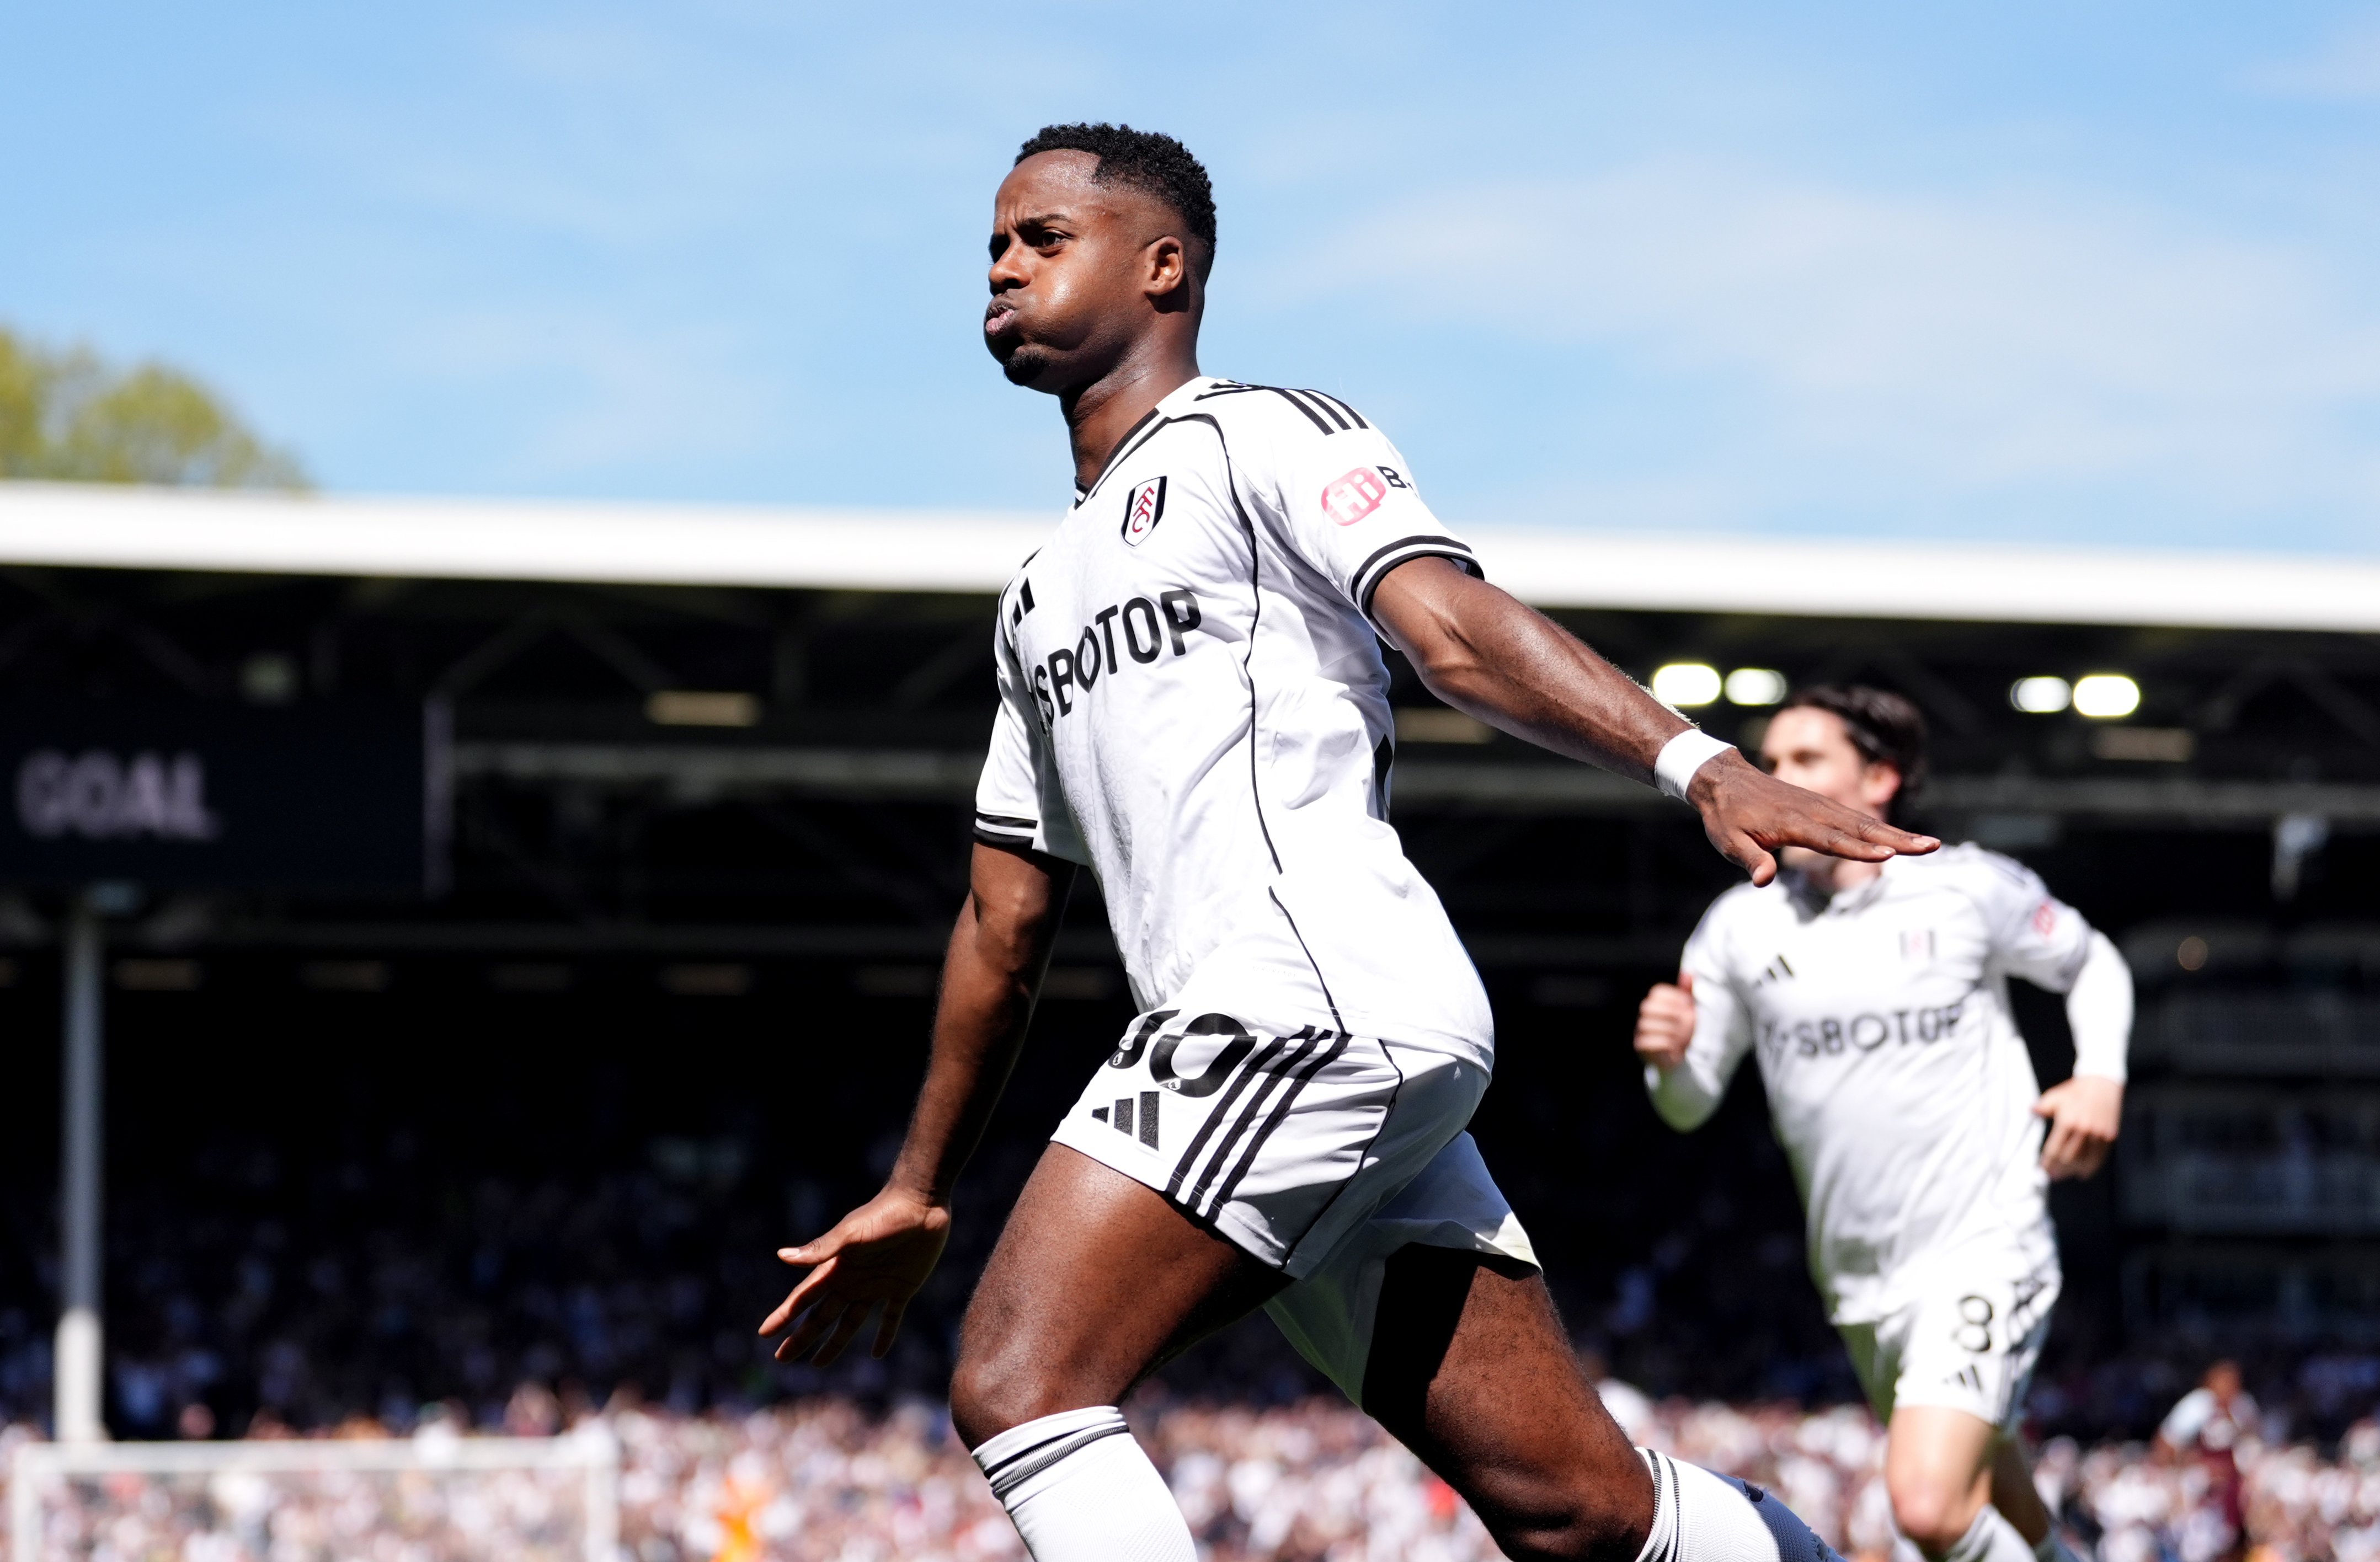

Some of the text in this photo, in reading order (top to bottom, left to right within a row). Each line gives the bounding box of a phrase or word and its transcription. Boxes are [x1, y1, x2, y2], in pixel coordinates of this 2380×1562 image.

[1132, 486, 1155, 533] FFC
[1326, 466, 1414, 522] Hi B
[1035, 590, 1202, 729] SBOTOP
[15, 749, 220, 842] GOAL
